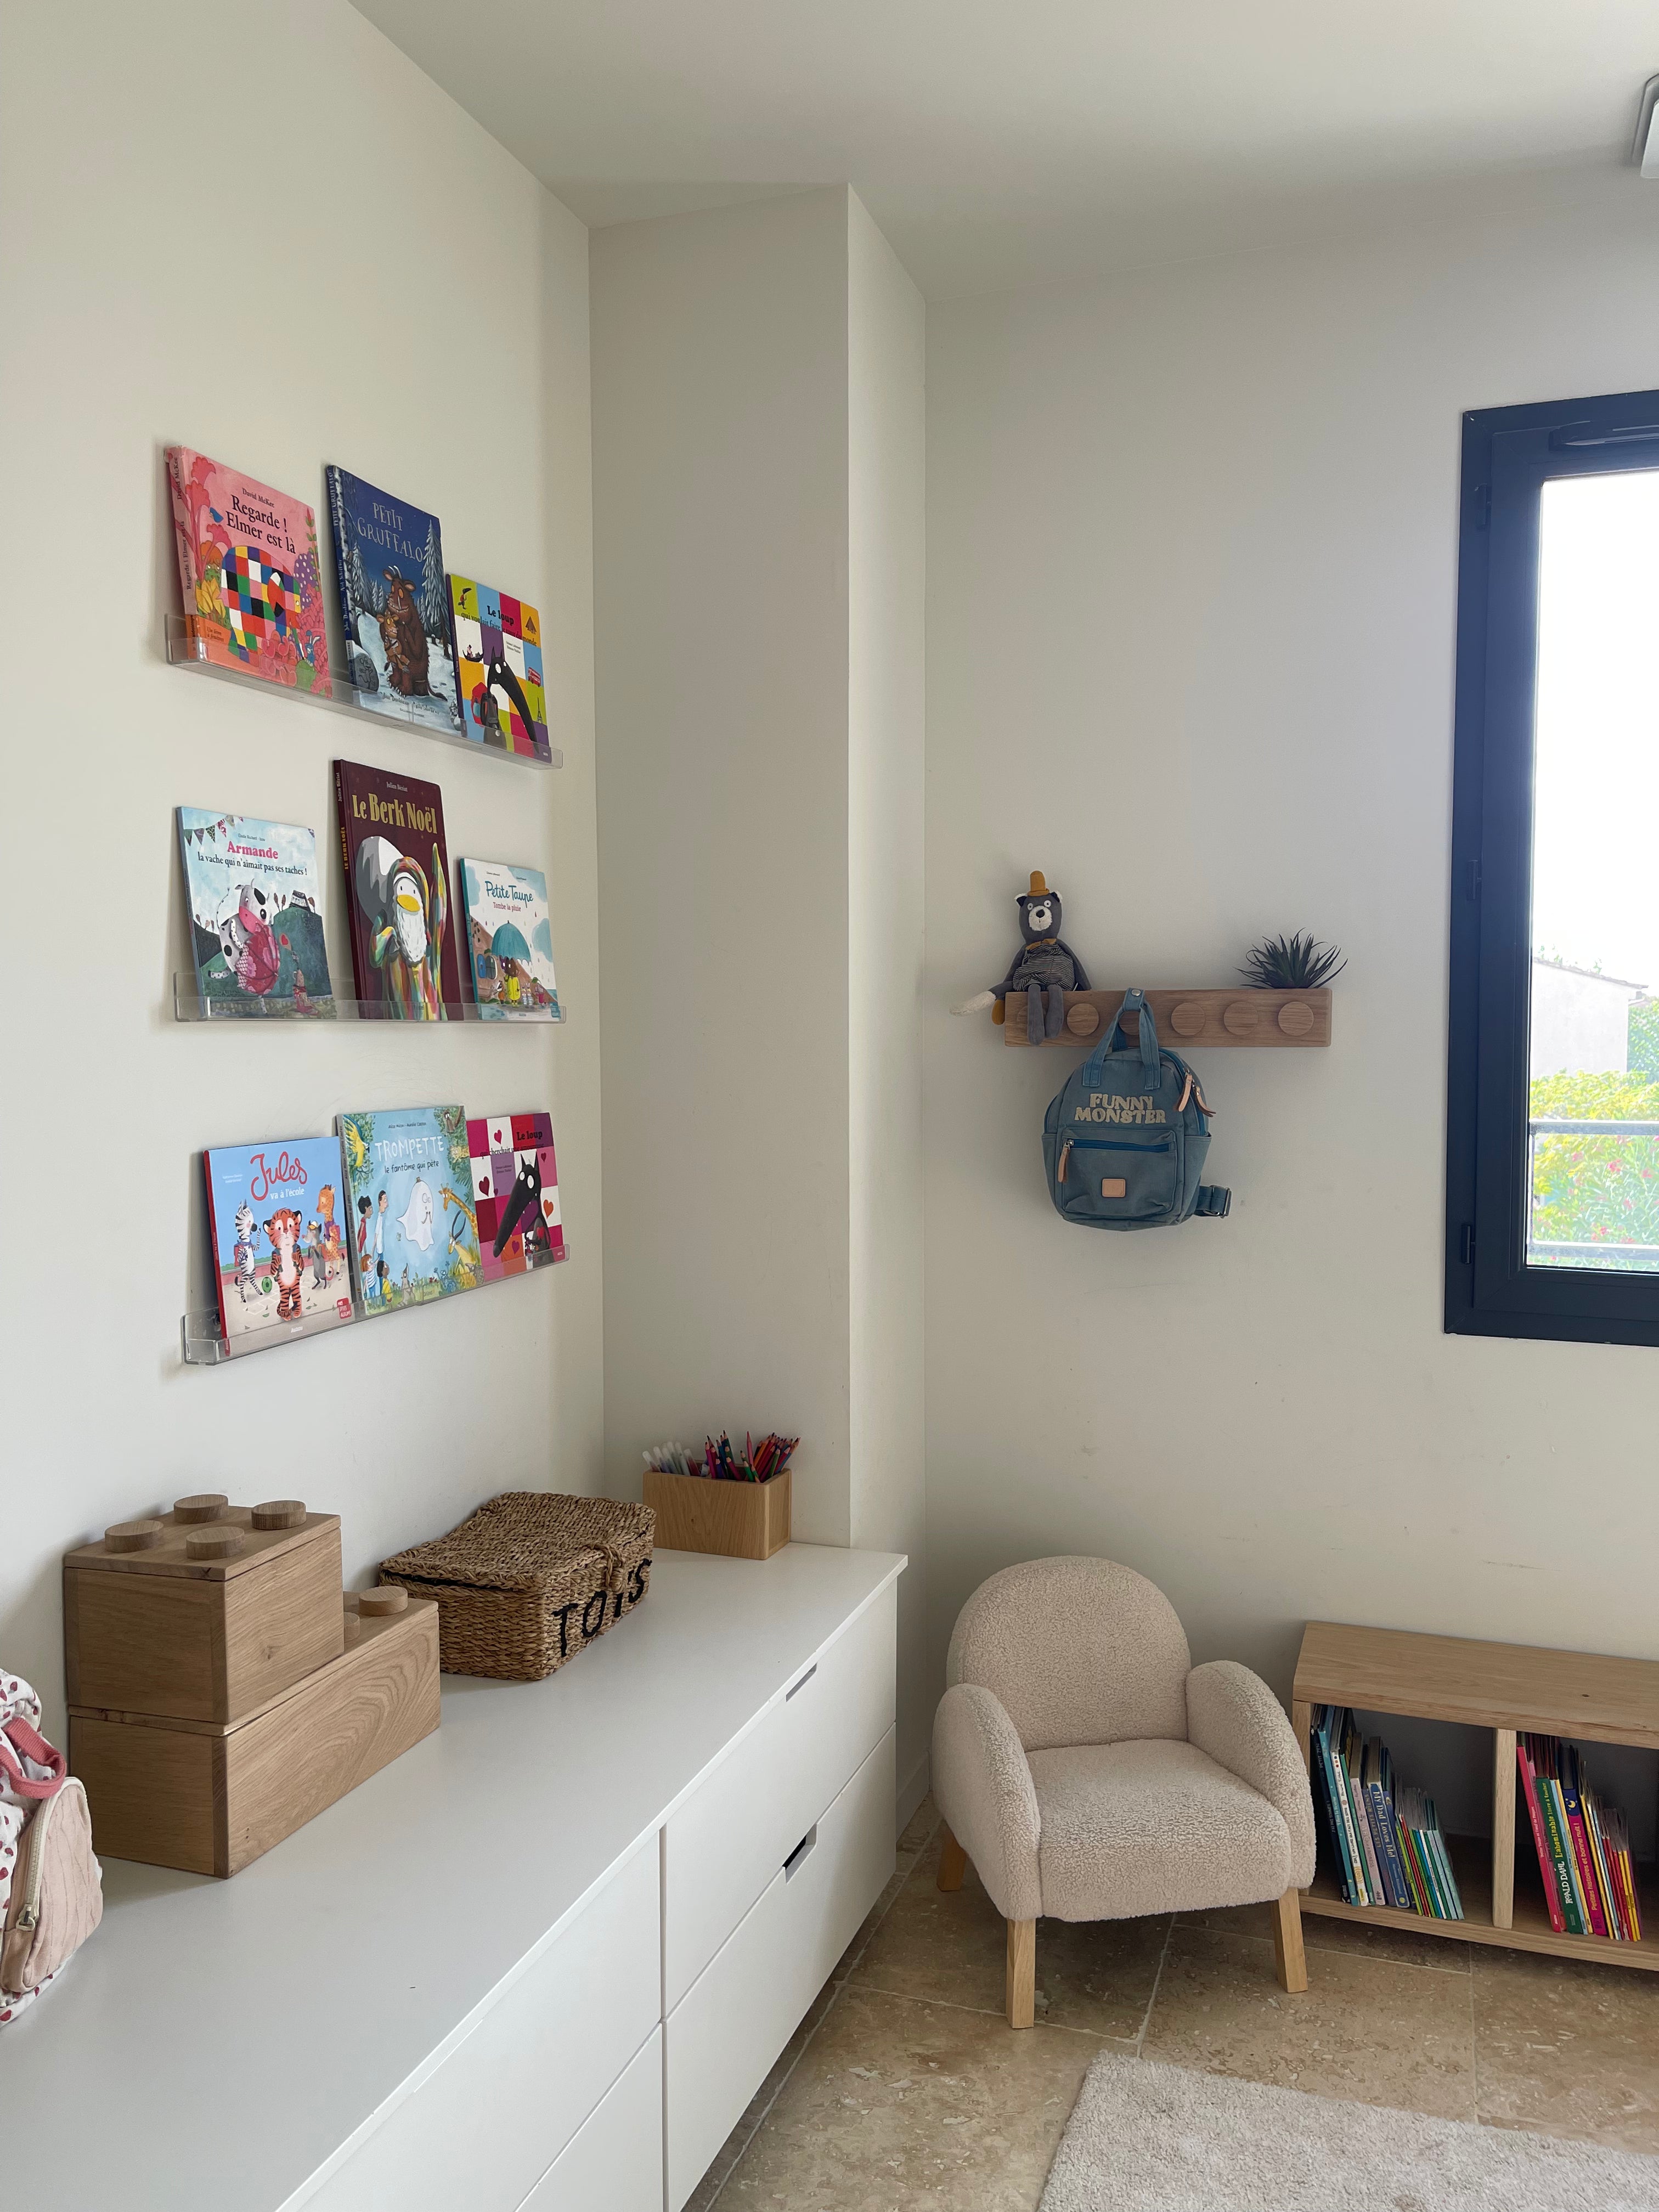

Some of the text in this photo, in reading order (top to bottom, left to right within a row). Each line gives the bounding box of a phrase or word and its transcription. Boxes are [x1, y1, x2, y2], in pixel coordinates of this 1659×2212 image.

[242, 487, 275, 507] David McKee
[230, 494, 287, 533] Regarde !
[372, 502, 403, 531] PETIT
[225, 510, 296, 554] Elmer est là
[357, 517, 424, 562] GRUFFALO
[183, 560, 191, 590] Regarde
[461, 612, 471, 621] qui
[471, 614, 489, 627] voulait
[489, 620, 501, 631] faire
[487, 605, 515, 627] Le loup
[352, 793, 438, 834] Le Berk Noël
[227, 840, 279, 860] Armande
[198, 851, 205, 862] la
[206, 854, 224, 865] vache
[224, 857, 236, 868] qui
[236, 858, 263, 870] n'aimait
[263, 863, 274, 873] pas
[285, 865, 304, 876] taches
[484, 881, 534, 909] Petite Taupe
[493, 901, 506, 910] Tombe
[1089, 1092, 1154, 1111] FUNNY
[1074, 1106, 1166, 1125] MONSTER
[516, 1131, 543, 1141] Le loup
[374, 1136, 444, 1161] TROMPETTE
[250, 1151, 308, 1201] Jules
[385, 1159, 439, 1173] le fantôme qui pète
[280, 1189, 285, 1198] à
[285, 1186, 305, 1198] l'école
[1373, 1791, 1381, 1802] My
[1376, 1804, 1386, 1820] Dad
[1380, 1821, 1391, 1843] Loves
[1548, 1815, 1564, 1858] L'abominable
[1575, 1826, 1584, 1837] nuit
[1385, 1844, 1396, 1858] Me!
[1578, 1837, 1588, 1858] bonne
[1558, 1860, 1568, 1881] DAHL
[1584, 1865, 1594, 1890] histoires
[1563, 1881, 1573, 1904] ROALD
[1589, 1889, 1598, 1911] Petites
